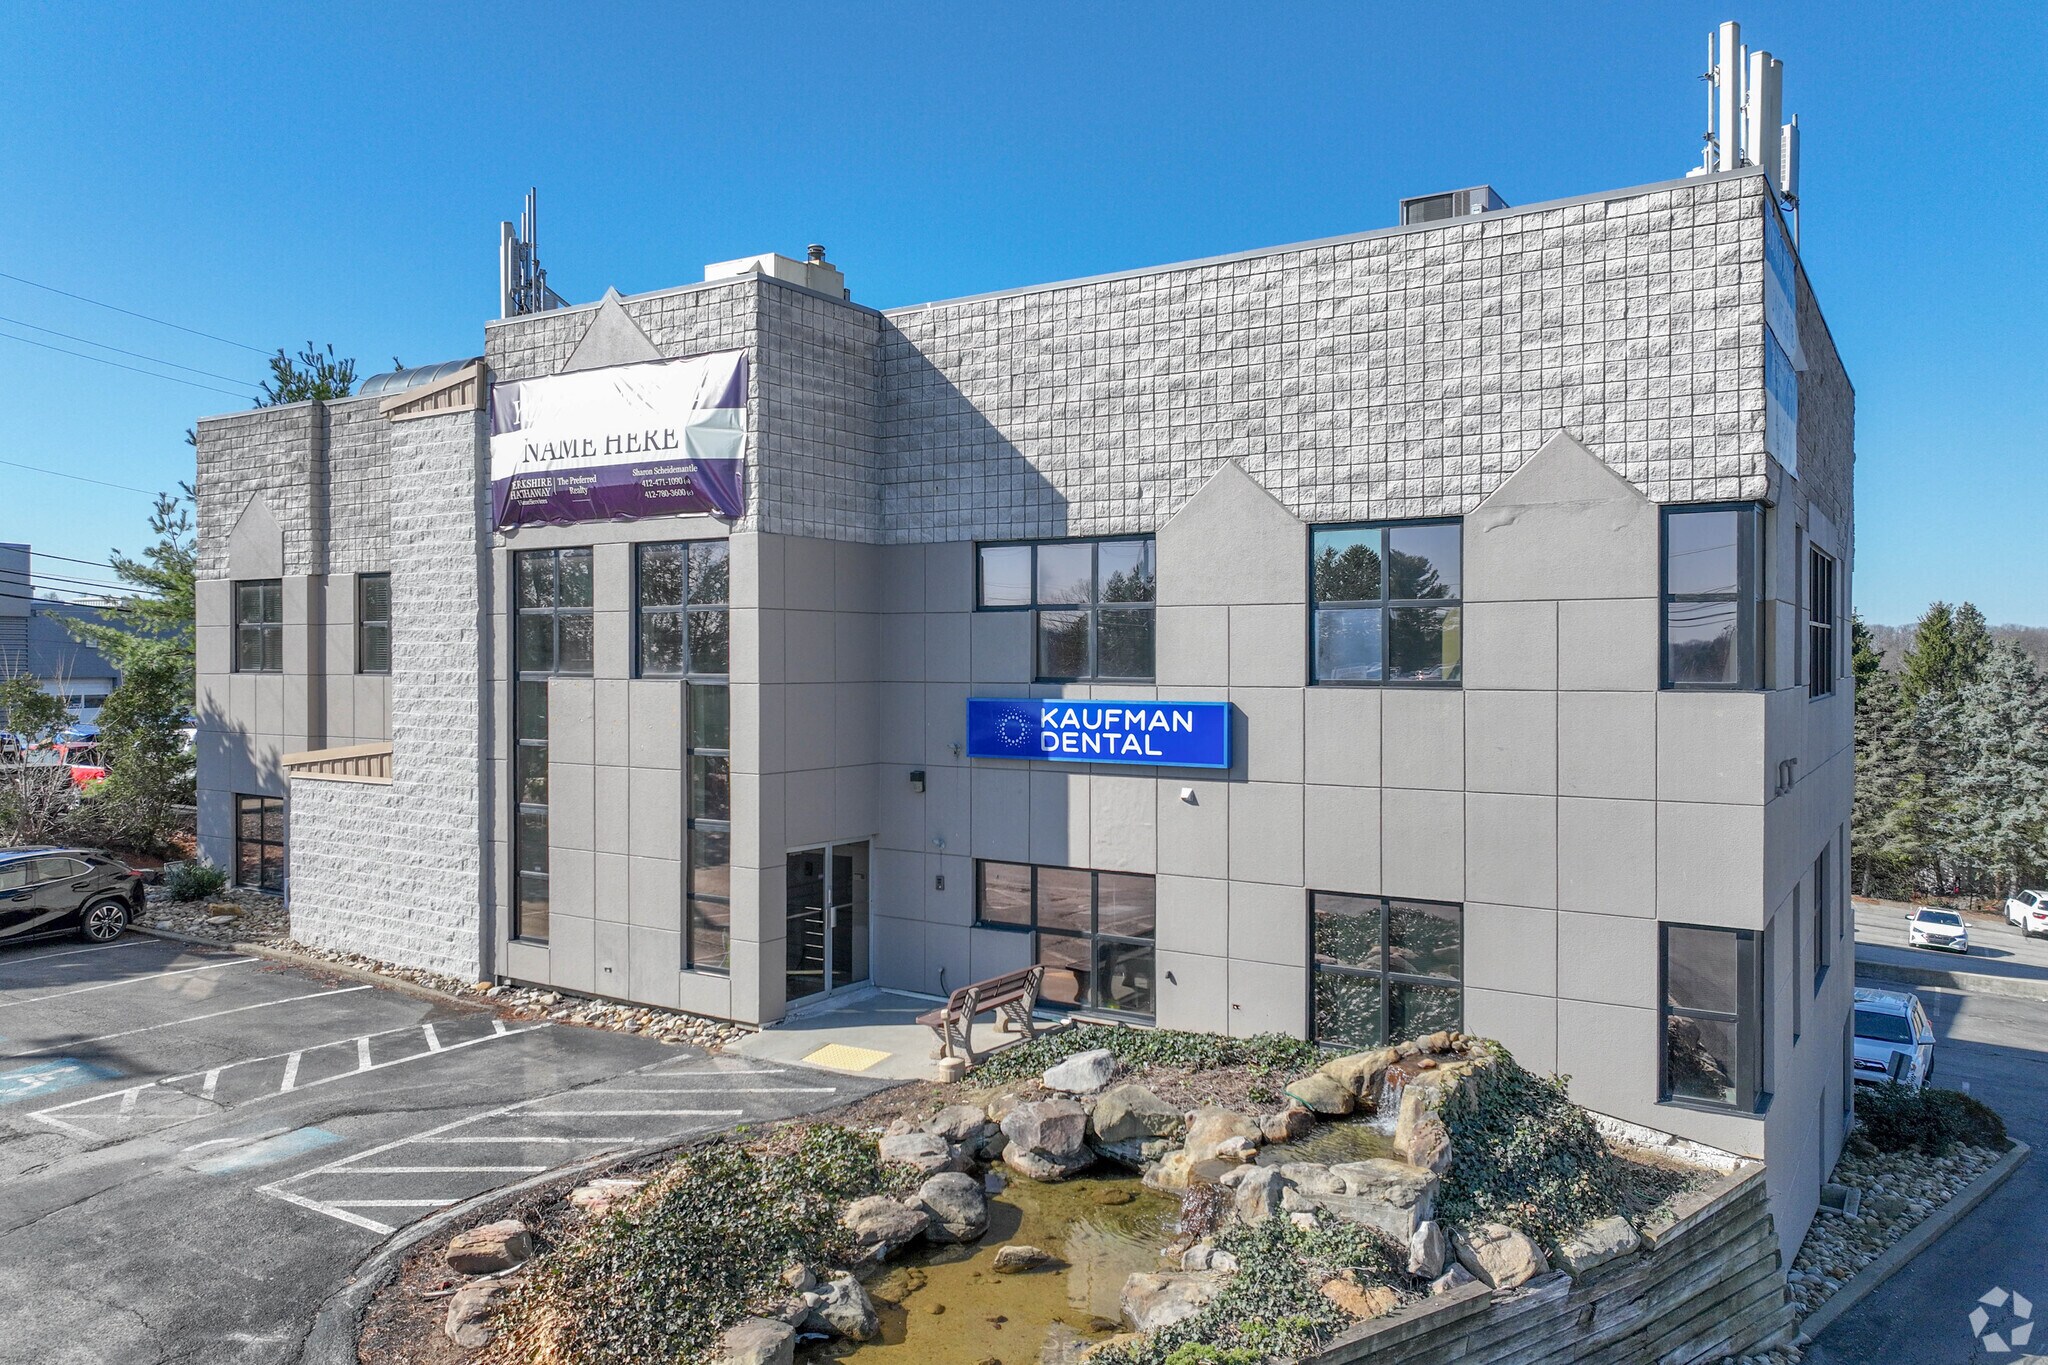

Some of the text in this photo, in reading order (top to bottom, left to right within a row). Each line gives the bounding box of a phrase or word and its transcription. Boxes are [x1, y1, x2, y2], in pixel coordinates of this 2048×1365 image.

[632, 463, 698, 477] Sharon Scheidemantle
[557, 474, 597, 486] The Preferred
[510, 487, 551, 500] HATHAWAY
[569, 485, 588, 496] Realty
[1040, 707, 1193, 733] KAUFMAN
[1040, 731, 1163, 756] DENTAL
